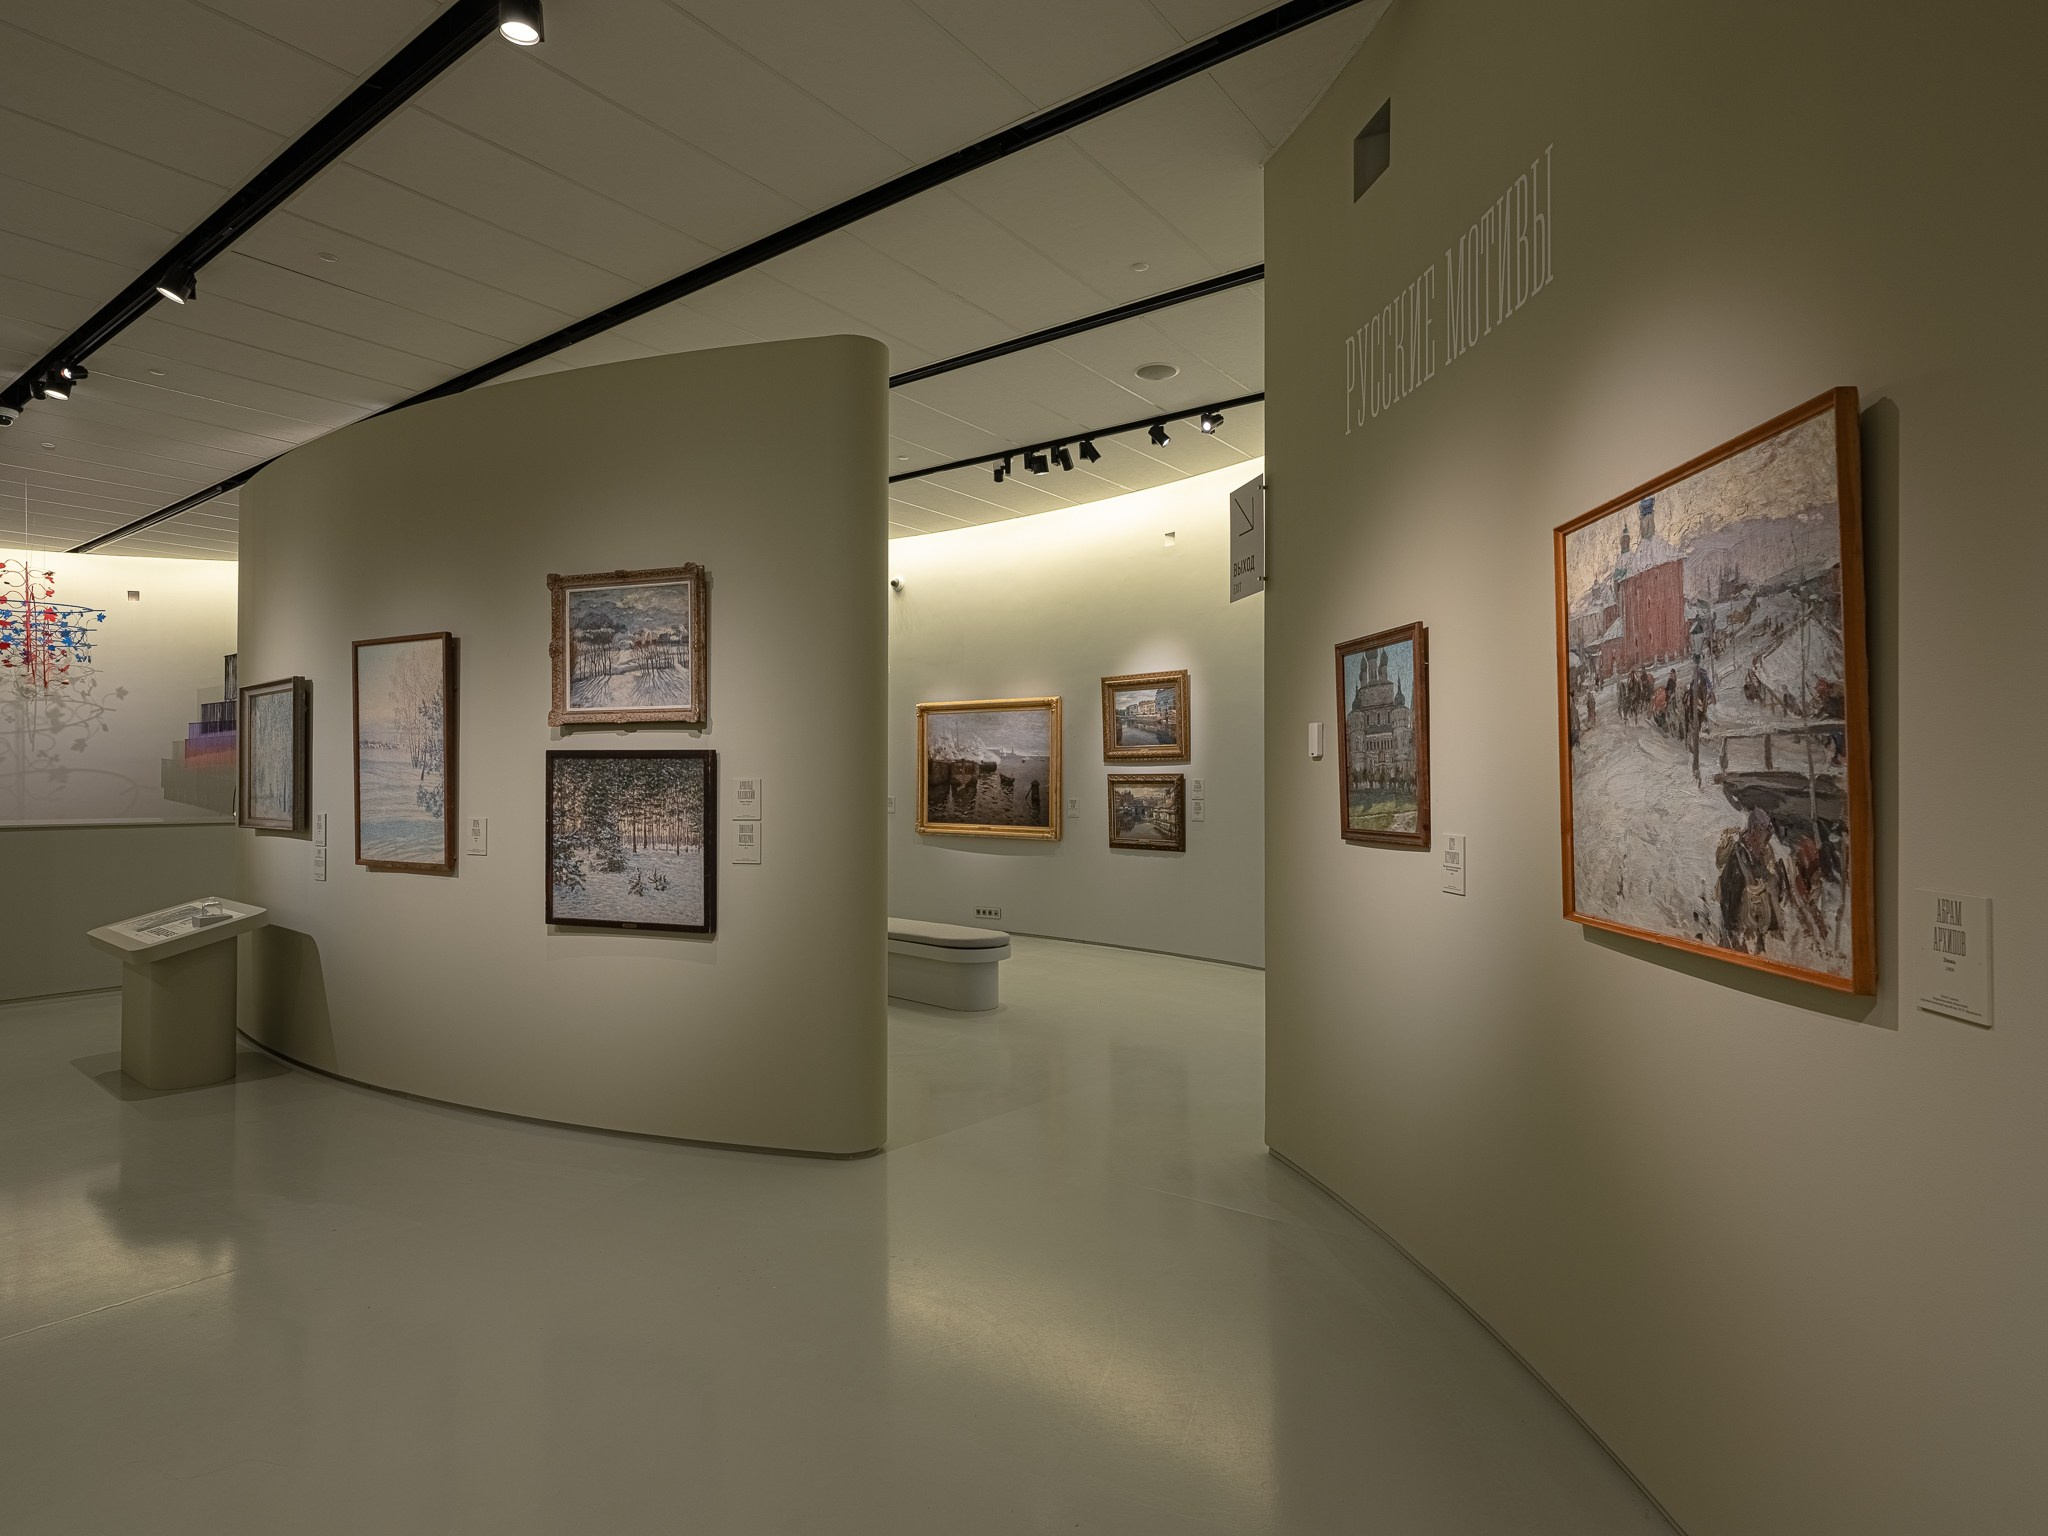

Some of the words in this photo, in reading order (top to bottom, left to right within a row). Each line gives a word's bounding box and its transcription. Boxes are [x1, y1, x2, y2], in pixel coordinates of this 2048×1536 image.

[1345, 264, 1435, 436] РУССКИЕ
[1445, 143, 1554, 366] МОТИВЫ
[1233, 554, 1255, 578] ВЫХОД
[1936, 898, 1962, 927] АБРАМ
[1933, 926, 1966, 956] АРХИПОВ
